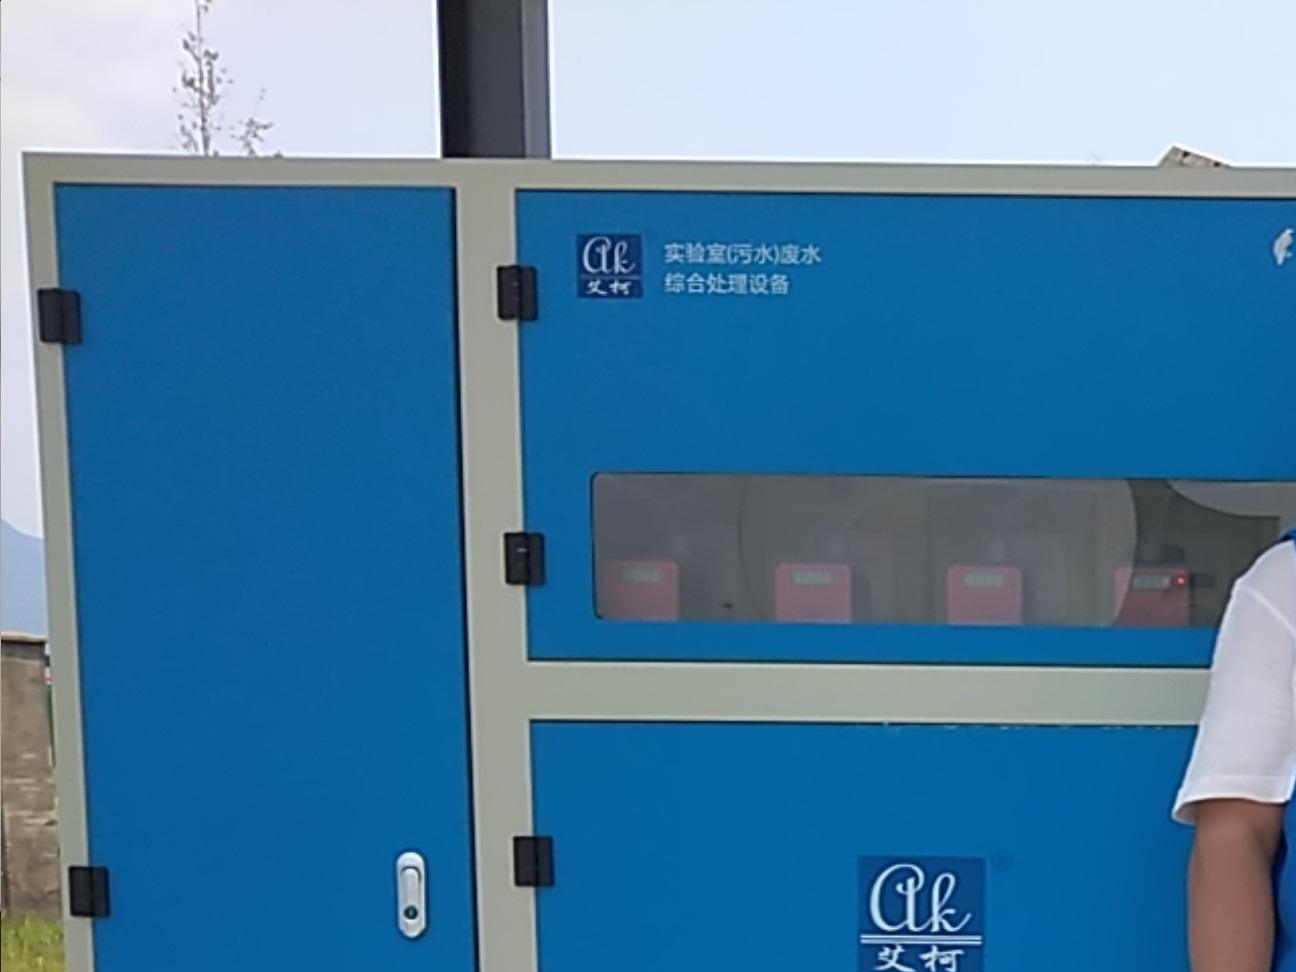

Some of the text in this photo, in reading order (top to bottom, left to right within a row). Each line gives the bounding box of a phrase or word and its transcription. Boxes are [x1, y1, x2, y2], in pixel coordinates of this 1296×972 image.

[664, 242, 822, 266] 实验室(污水)废水
[586, 280, 632, 296] 艾柯
[664, 272, 790, 295] 综合处理设备
